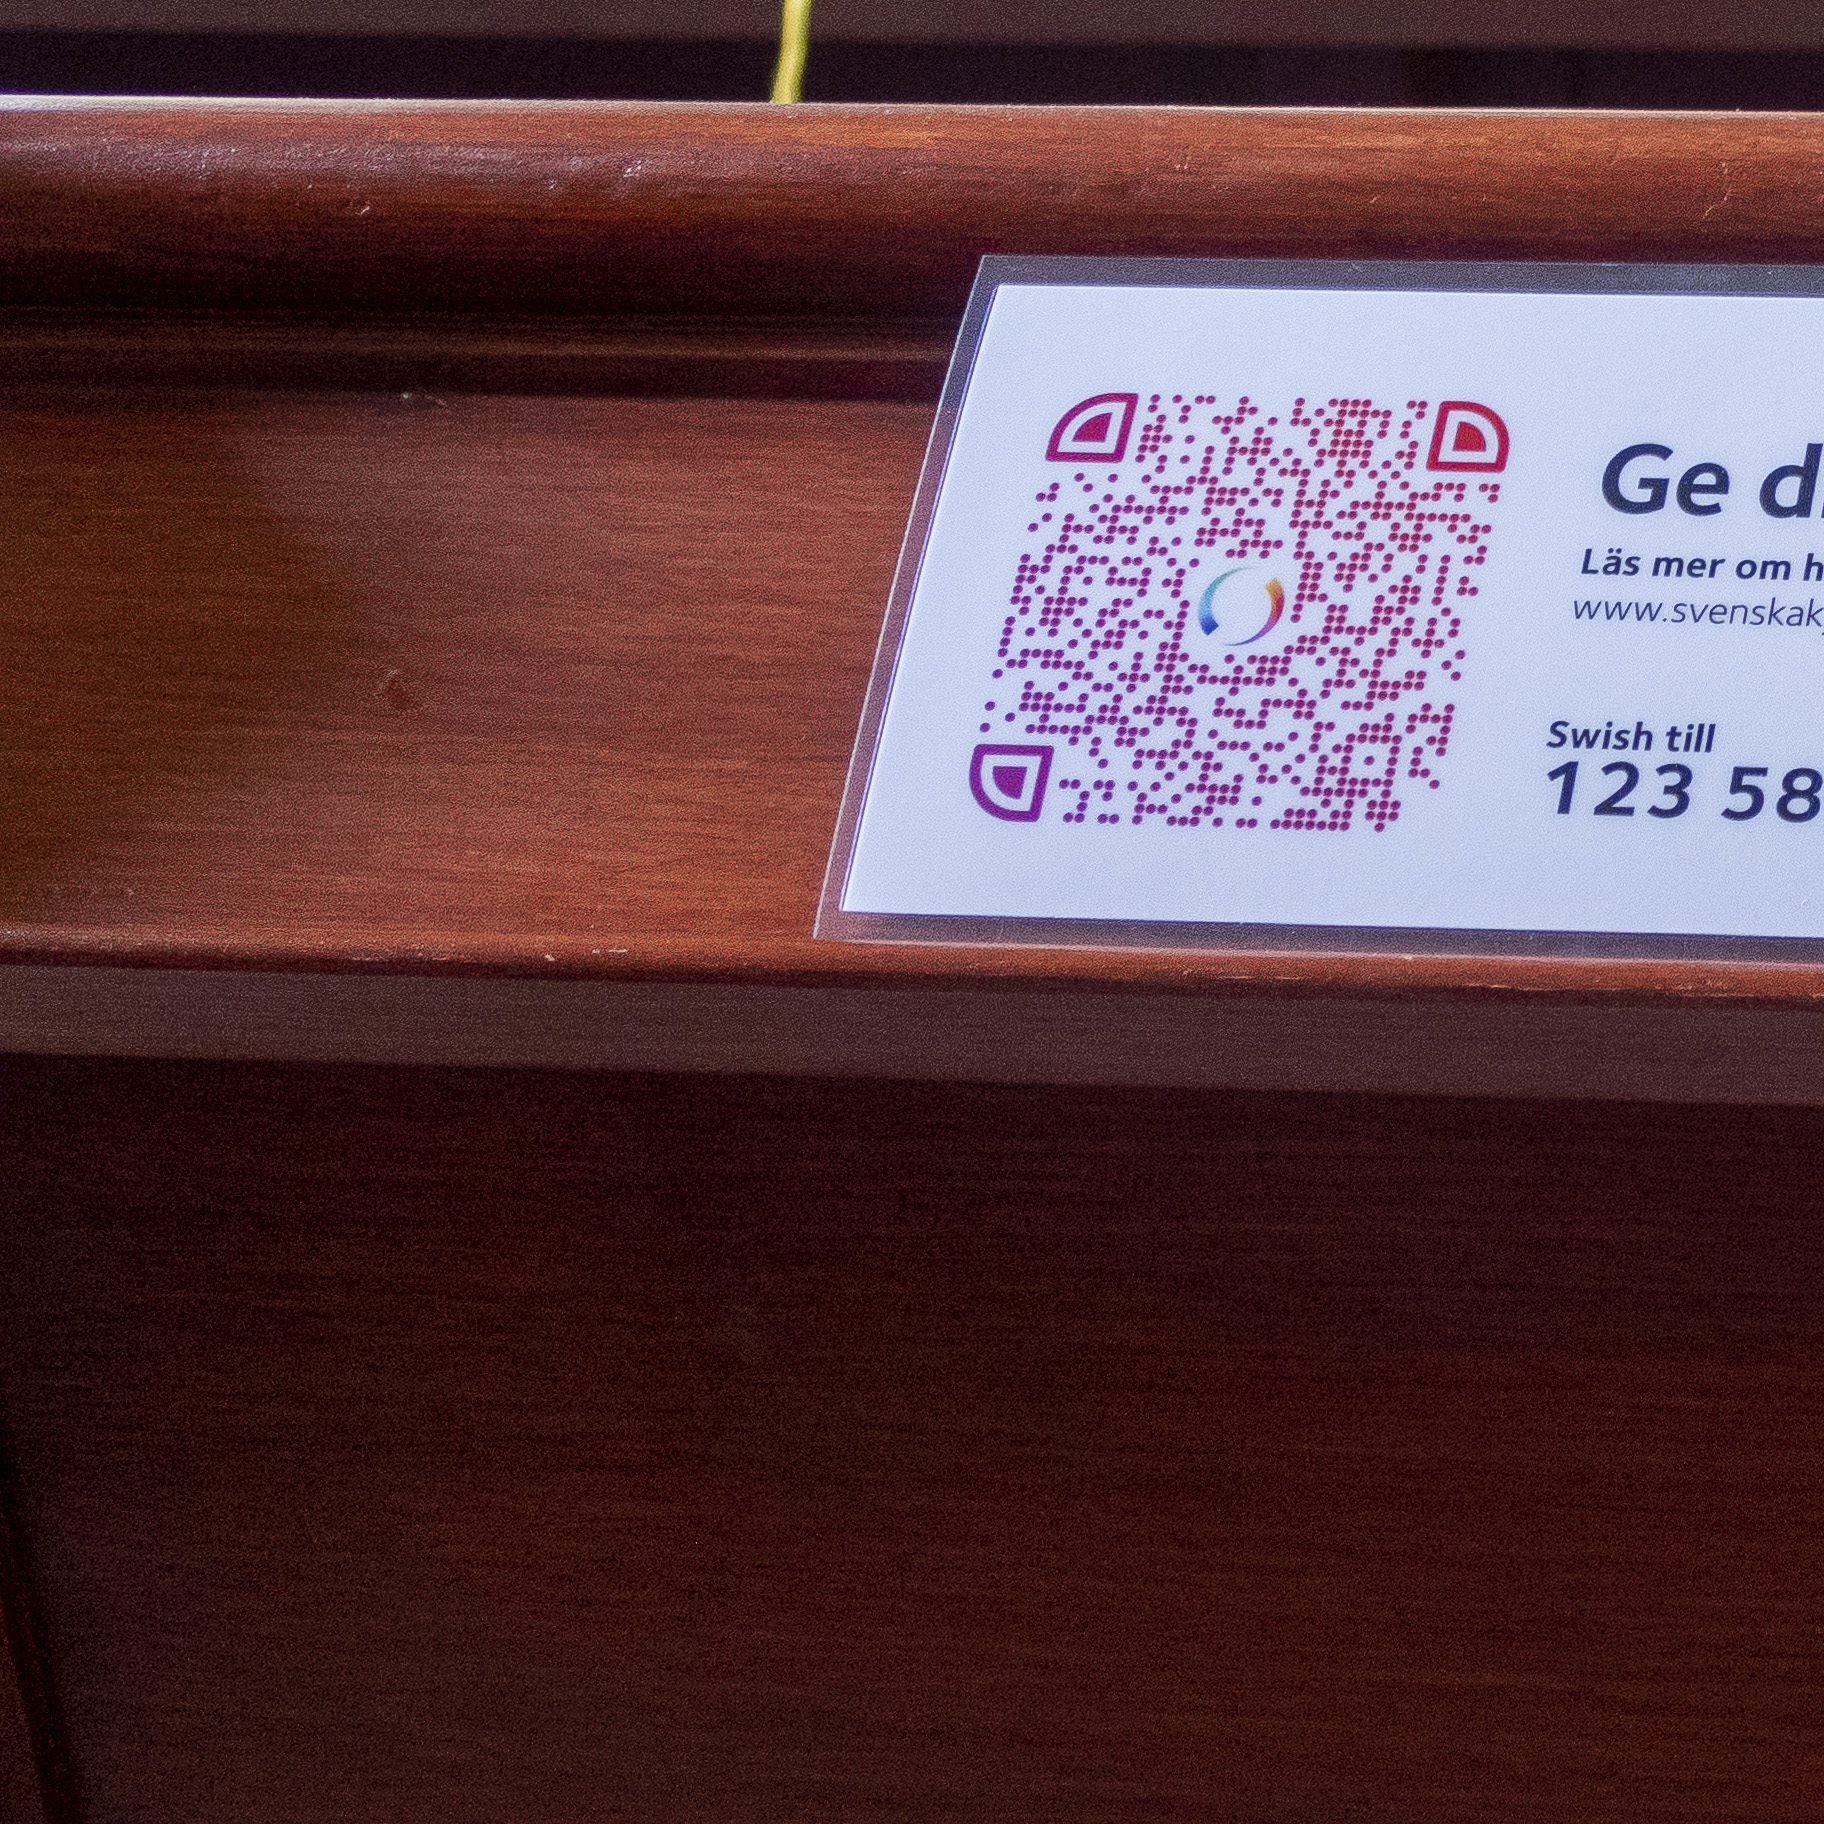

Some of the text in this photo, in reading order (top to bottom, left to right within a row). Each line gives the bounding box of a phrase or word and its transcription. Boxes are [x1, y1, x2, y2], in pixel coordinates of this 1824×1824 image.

[1601, 442, 1731, 517] Ge
[1580, 547, 1641, 577] Läs
[1651, 556, 1726, 580] mer
[1735, 558, 1792, 581] om
[1546, 719, 1717, 754] Swish till
[1547, 760, 1694, 819] 123
